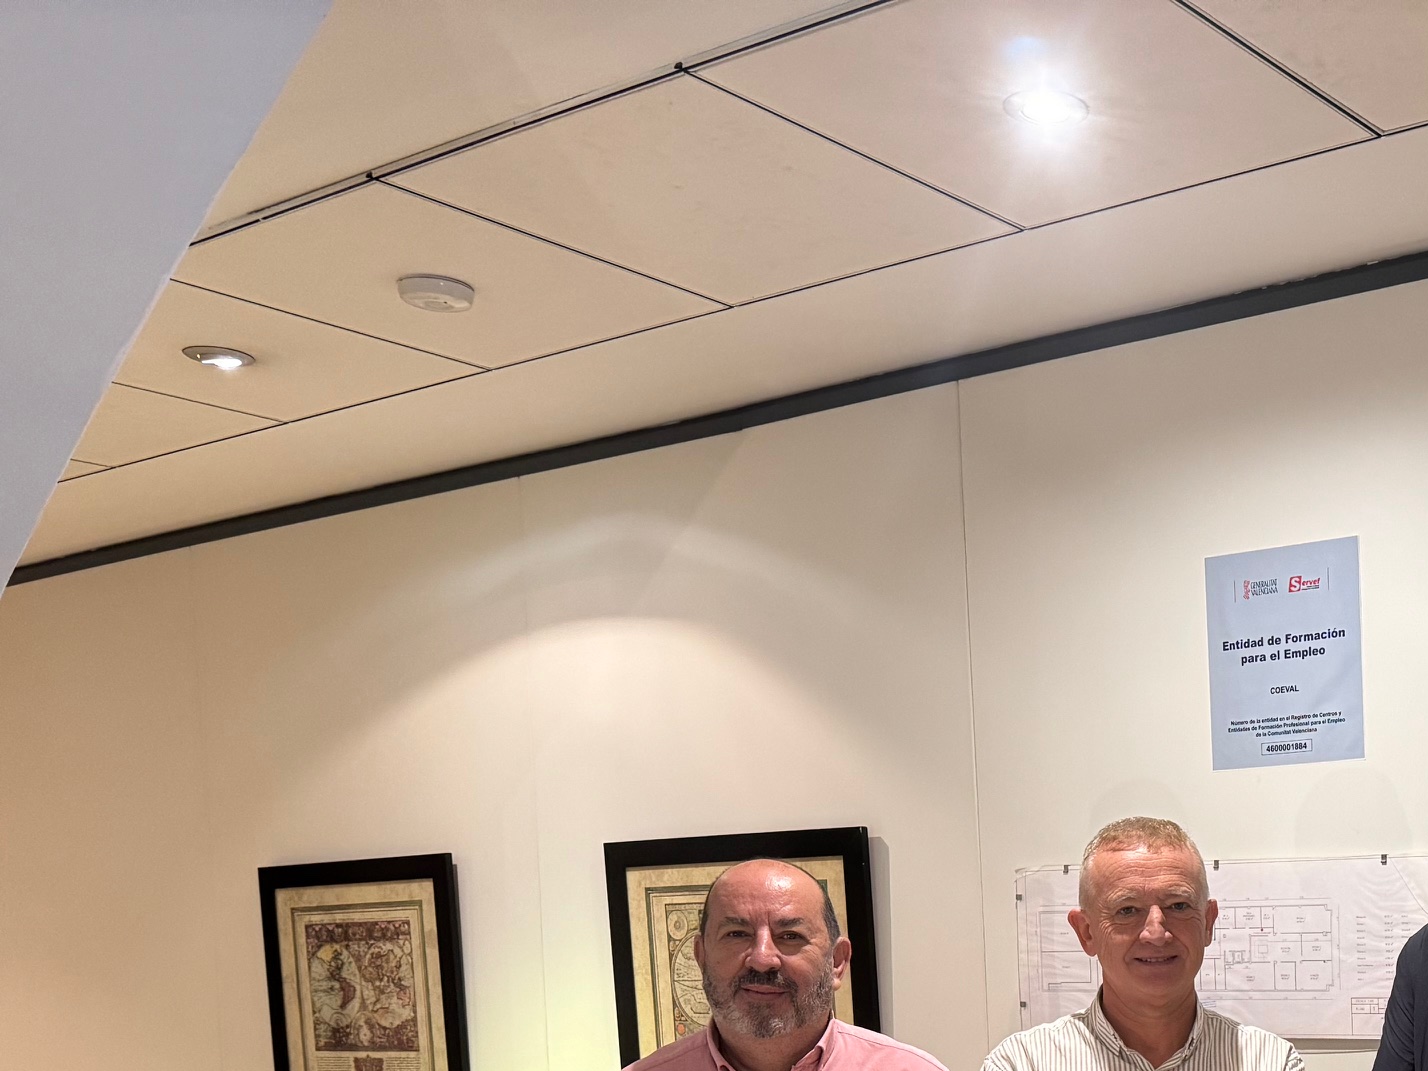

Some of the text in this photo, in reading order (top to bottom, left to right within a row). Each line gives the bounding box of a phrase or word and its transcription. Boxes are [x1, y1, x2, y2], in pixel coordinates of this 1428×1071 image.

[1223, 628, 1346, 651] Entidad de Formación
[1241, 646, 1326, 666] para el Empleo
[1270, 684, 1299, 695] COEVAL
[1291, 713, 1311, 721] Registro
[1258, 723, 1283, 731] Formación
